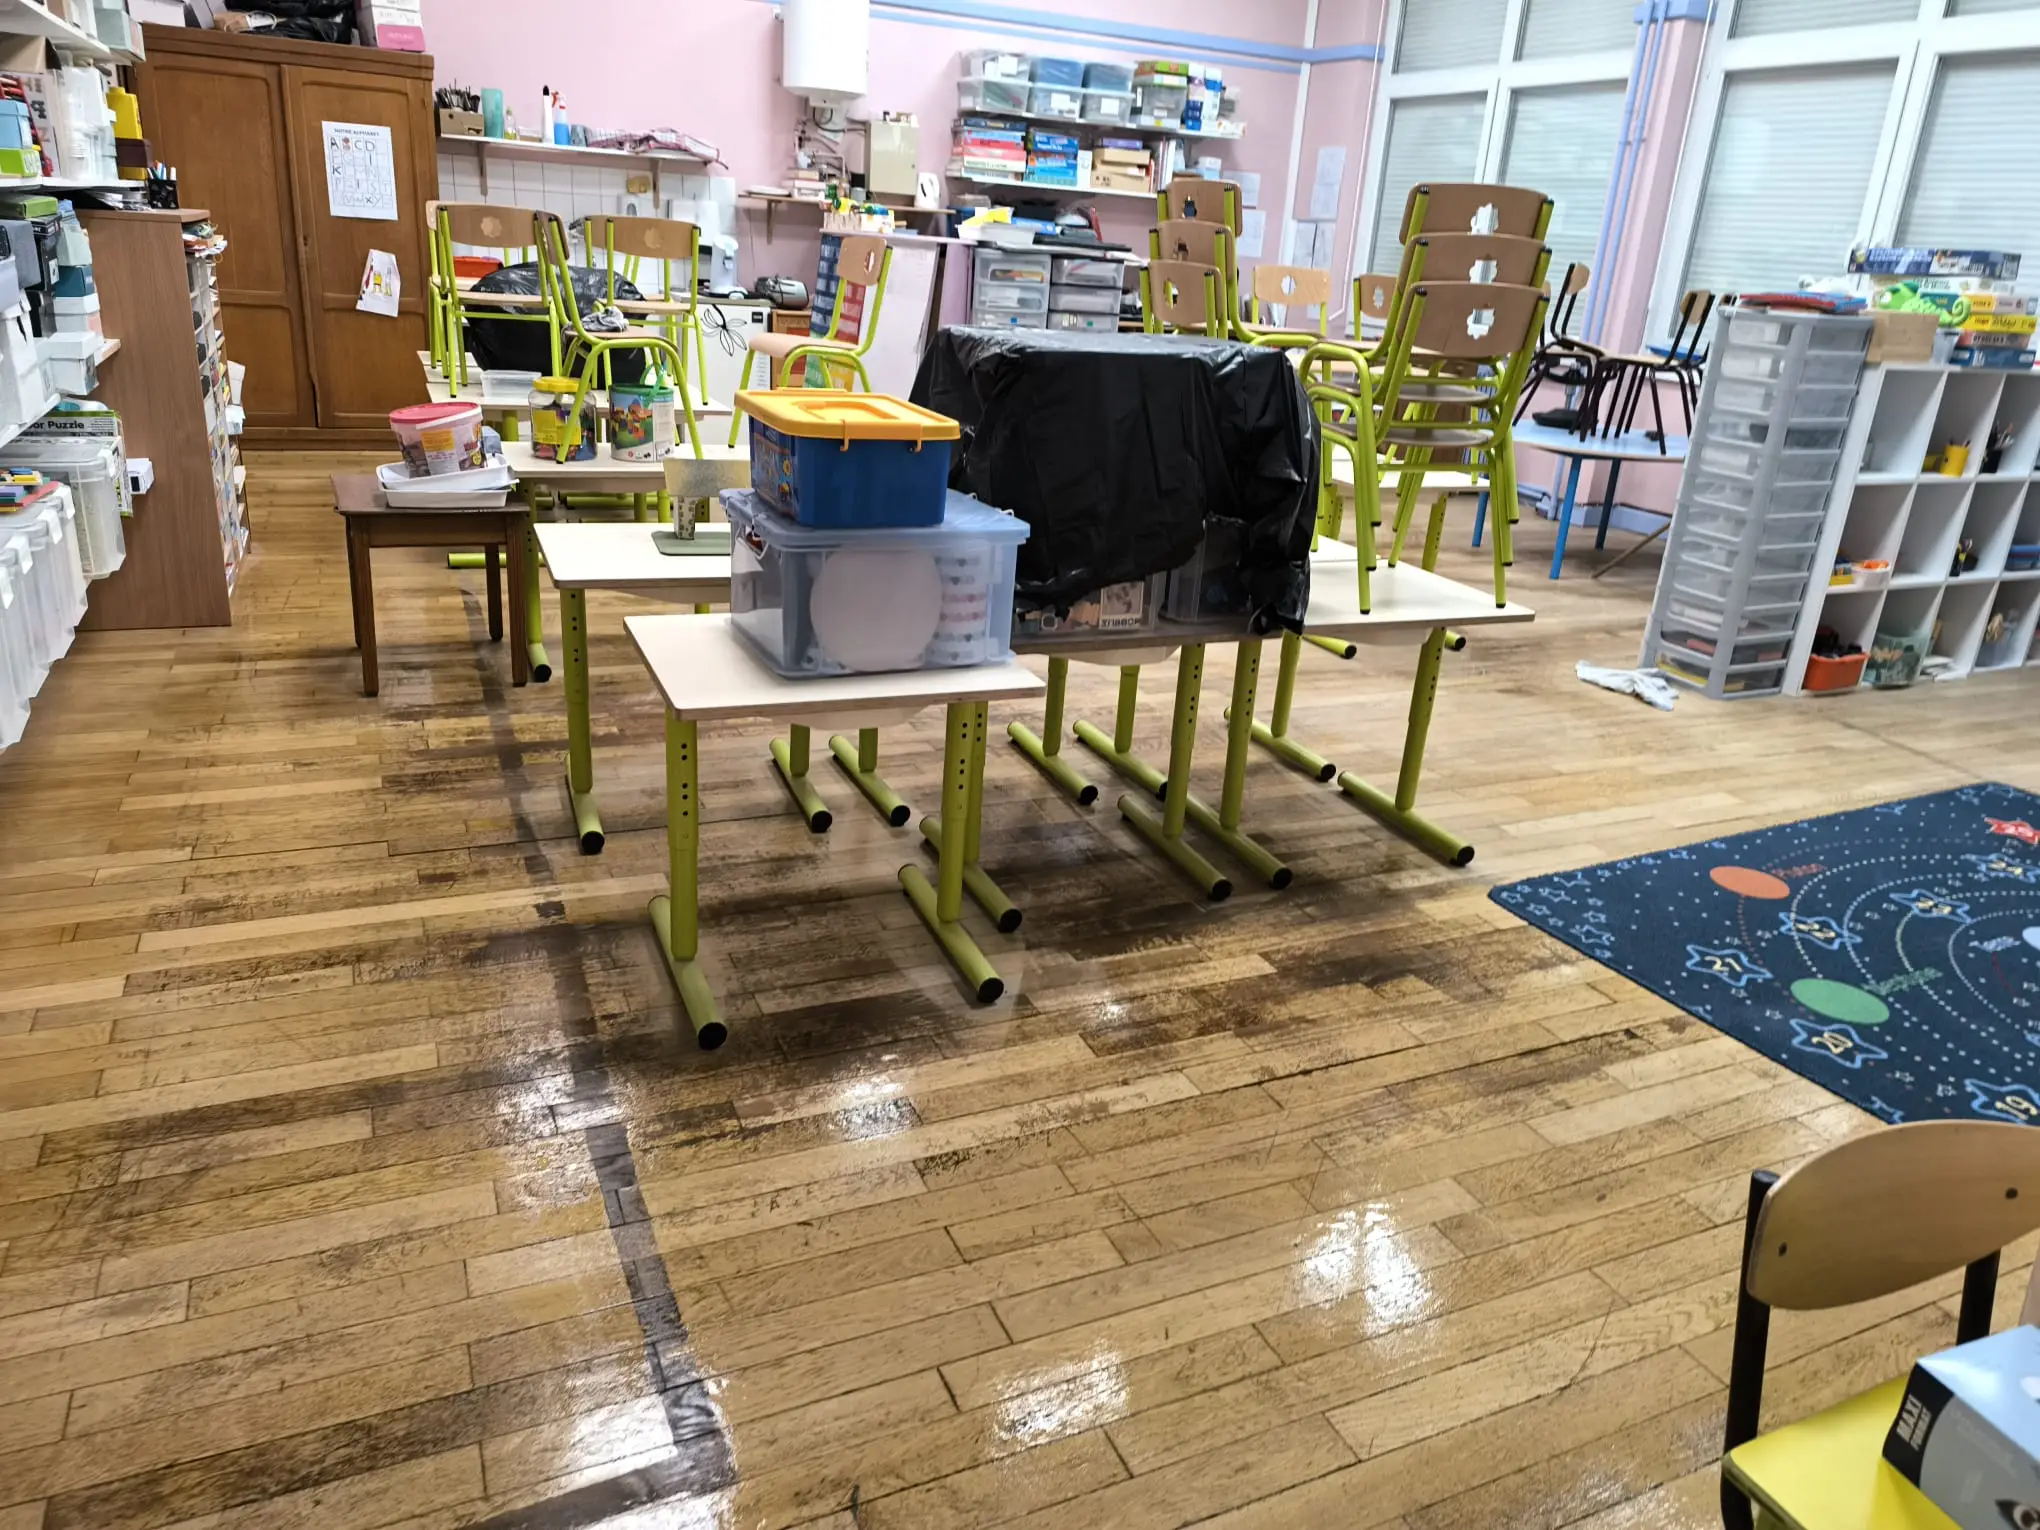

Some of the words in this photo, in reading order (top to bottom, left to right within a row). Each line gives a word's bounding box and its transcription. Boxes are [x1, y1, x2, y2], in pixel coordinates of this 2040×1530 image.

[47, 420, 85, 430] Puzzle
[1703, 955, 1744, 973] 21
[1994, 1095, 2039, 1121] 19
